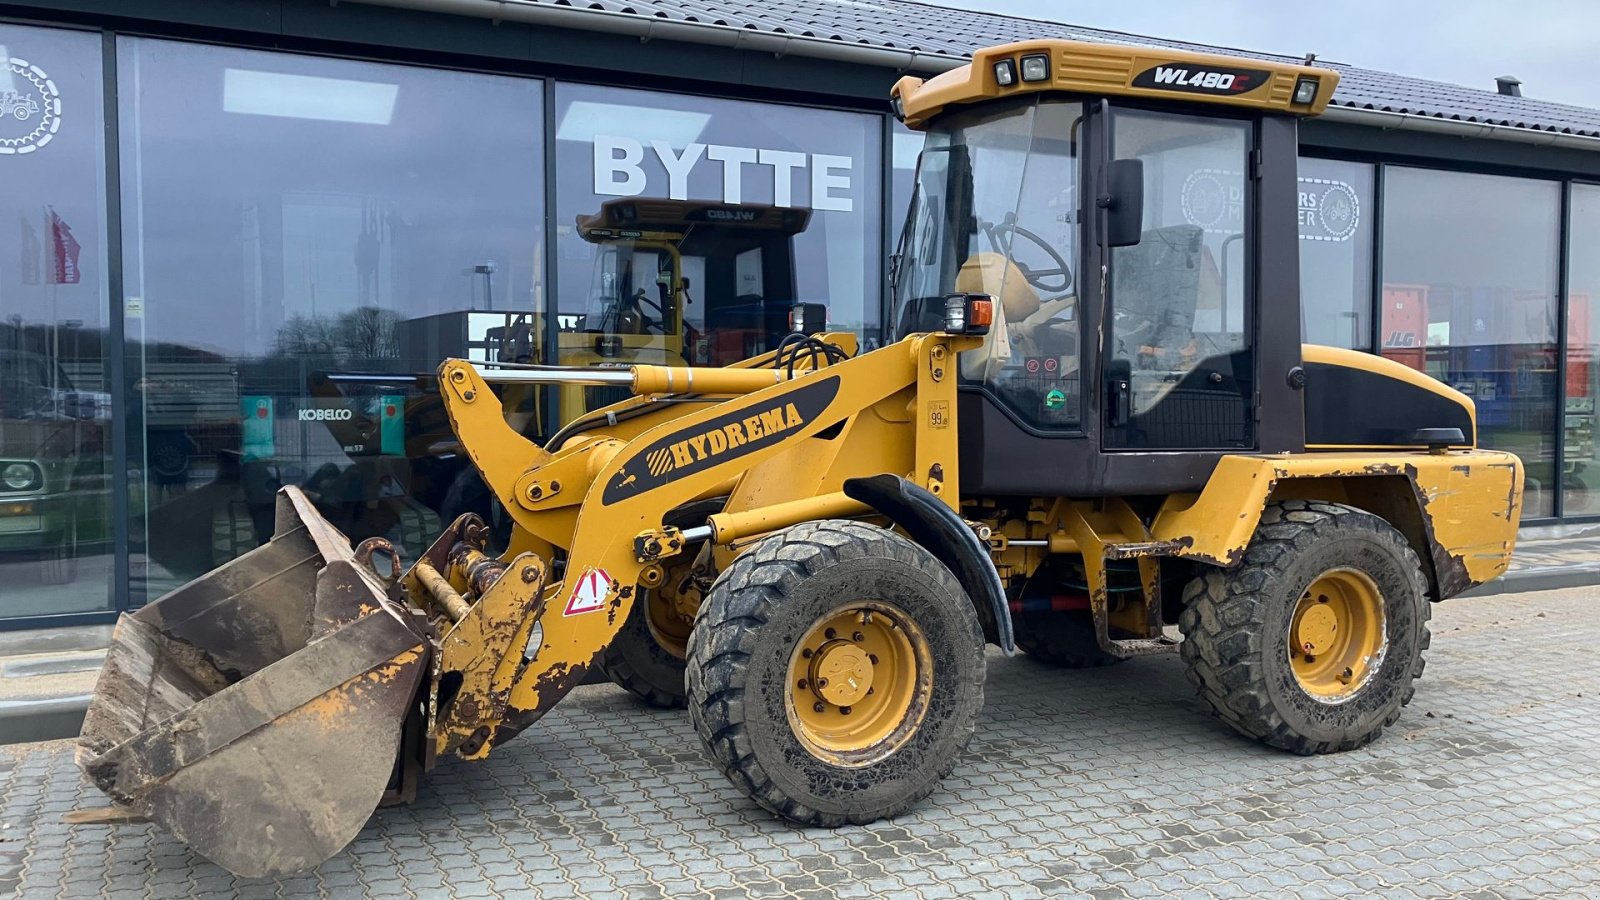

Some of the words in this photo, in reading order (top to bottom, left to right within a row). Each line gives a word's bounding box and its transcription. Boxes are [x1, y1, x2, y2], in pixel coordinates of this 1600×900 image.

[1154, 66, 1250, 91] WL480C
[593, 134, 853, 212] BYTTE
[1385, 331, 1415, 347] JLG
[298, 408, 352, 421] KOBELCO
[931, 412, 942, 425] 99
[669, 402, 804, 469] HYDREMA
